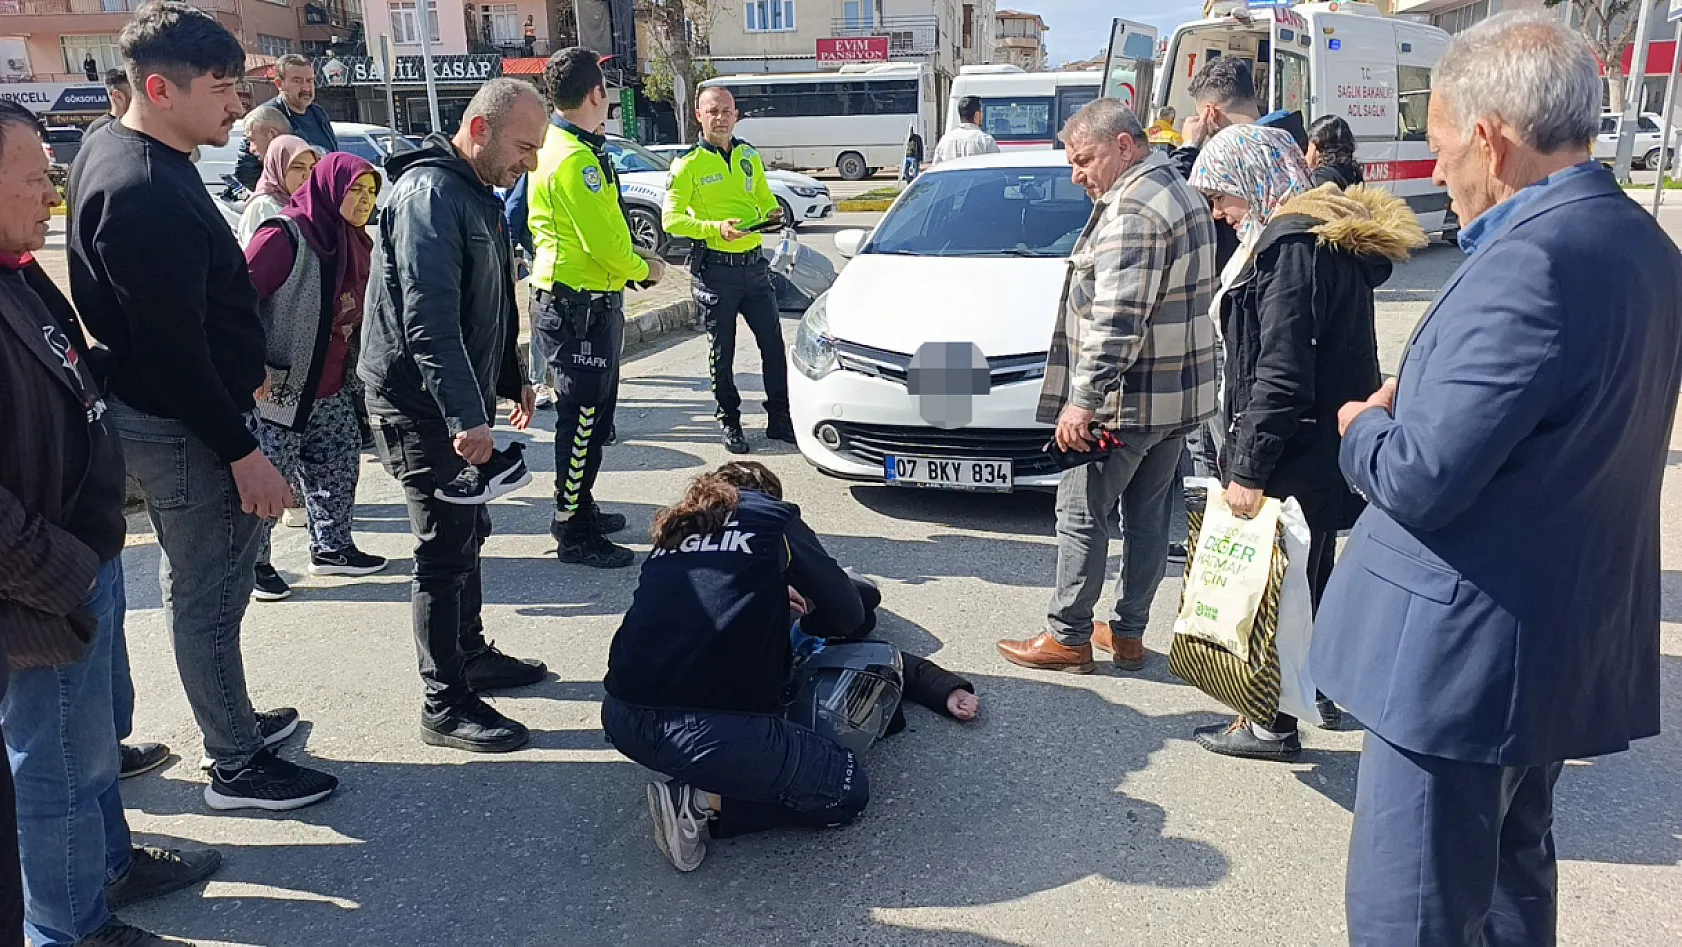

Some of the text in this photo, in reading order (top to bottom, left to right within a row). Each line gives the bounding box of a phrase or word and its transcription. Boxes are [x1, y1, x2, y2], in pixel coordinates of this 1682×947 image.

[354, 58, 419, 79] SAİL
[1, 92, 50, 103] RKCELL
[1360, 163, 1389, 180] LANS
[897, 459, 917, 478] 07
[927, 461, 961, 482] BKY
[971, 463, 1008, 483] 834
[1204, 535, 1256, 562] DEĞER
